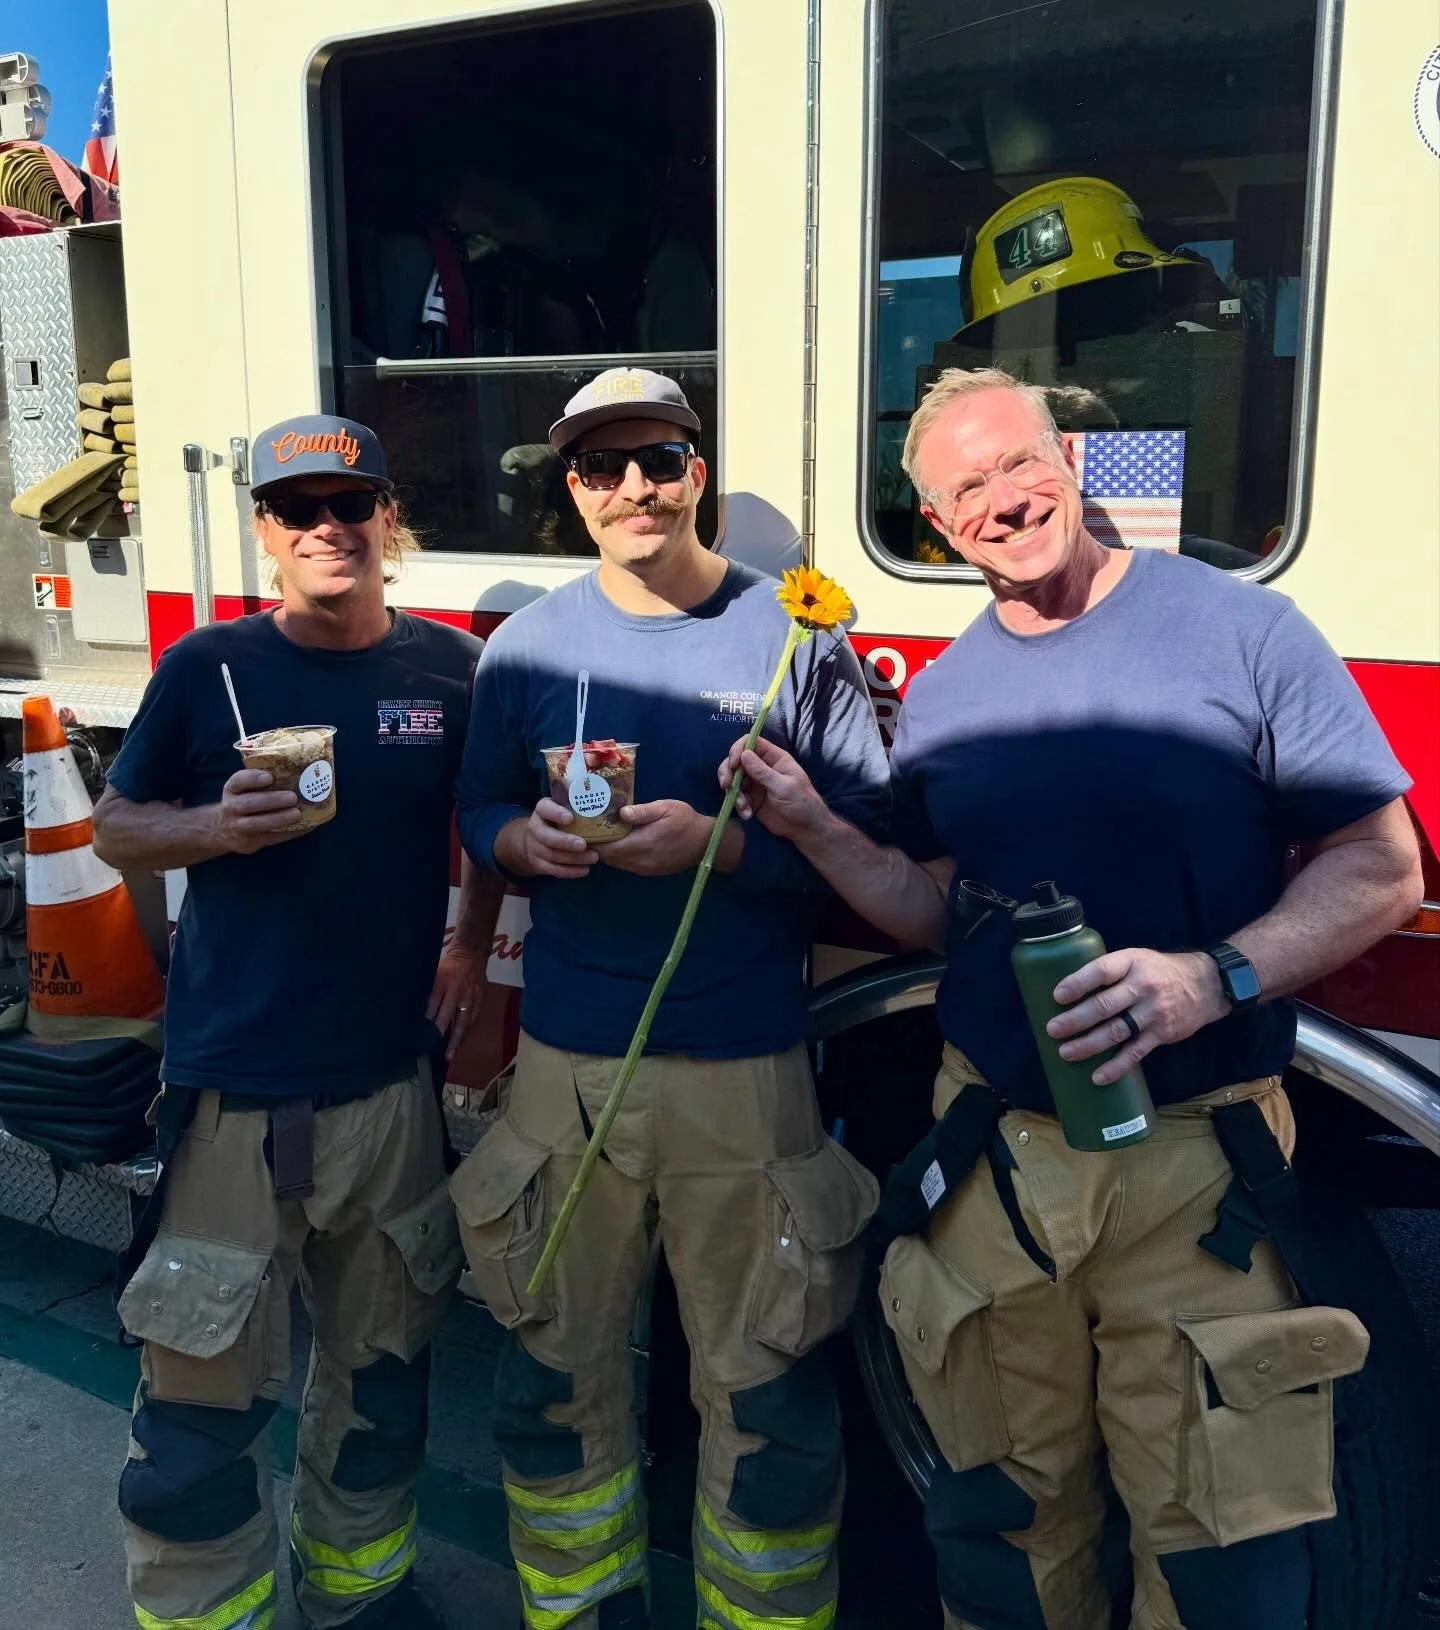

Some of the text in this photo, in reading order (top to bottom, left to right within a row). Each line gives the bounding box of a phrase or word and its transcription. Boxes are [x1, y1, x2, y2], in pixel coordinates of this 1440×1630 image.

[271, 427, 361, 466] County
[700, 691, 738, 699] ORANGE
[720, 701, 755, 714] FIRE
[378, 710, 443, 735] FIRE
[711, 713, 759, 724] AUTHORIT
[574, 791, 605, 800] GARDEN
[575, 796, 605, 806] DISTRICT
